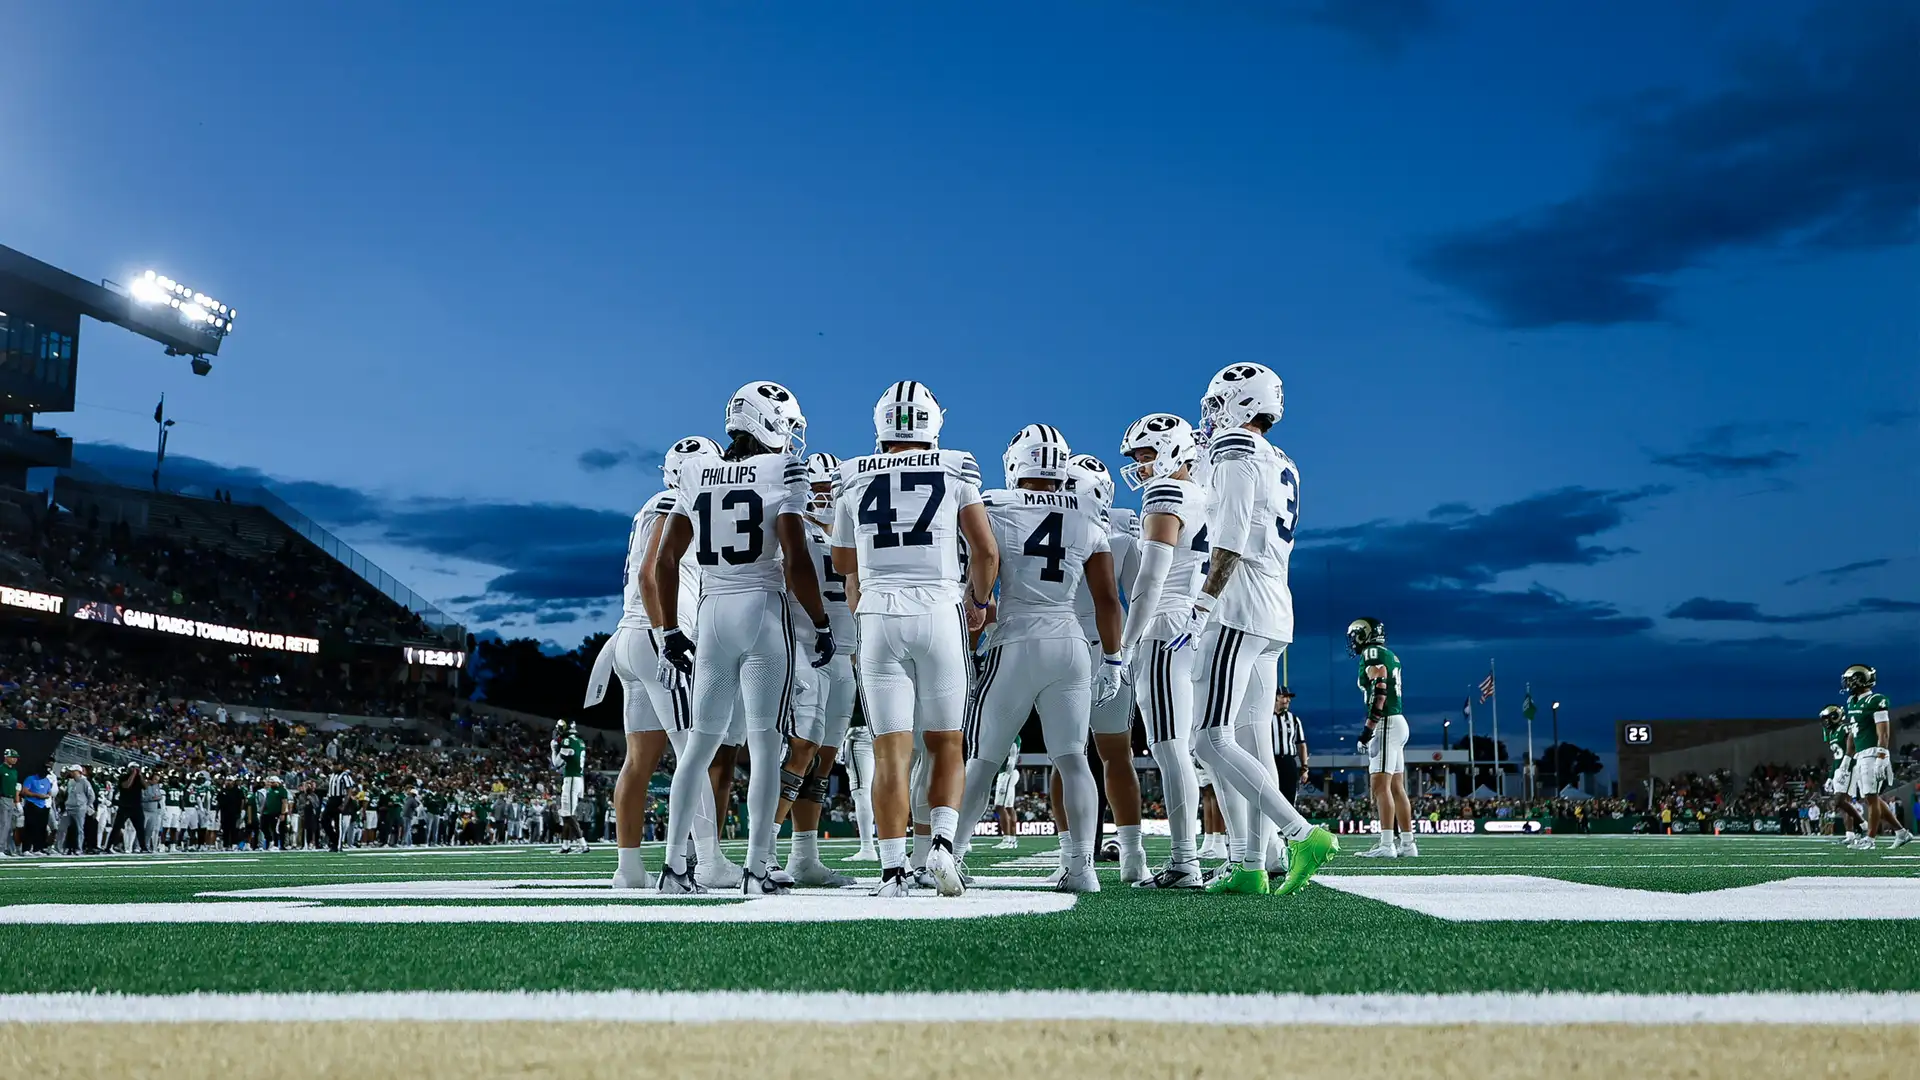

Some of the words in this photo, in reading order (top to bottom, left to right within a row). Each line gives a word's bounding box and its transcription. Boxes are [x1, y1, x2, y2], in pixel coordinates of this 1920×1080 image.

[858, 453, 940, 473] BACHMEIER
[701, 466, 756, 486] PHILLIPS
[858, 472, 946, 549] 47
[1024, 493, 1078, 510] MARTIN
[693, 489, 763, 565] 13
[1023, 512, 1065, 583] 4
[123, 609, 155, 630] GAIN
[156, 615, 195, 636] YARDS
[195, 622, 249, 645] TOWARDS
[249, 631, 285, 649] YOUR
[1363, 647, 1378, 661] 10
[1879, 699, 1886, 708] 4
[1629, 727, 1648, 741] 25
[1002, 822, 1055, 835] LGATES
[1418, 820, 1475, 833] TALGATES
